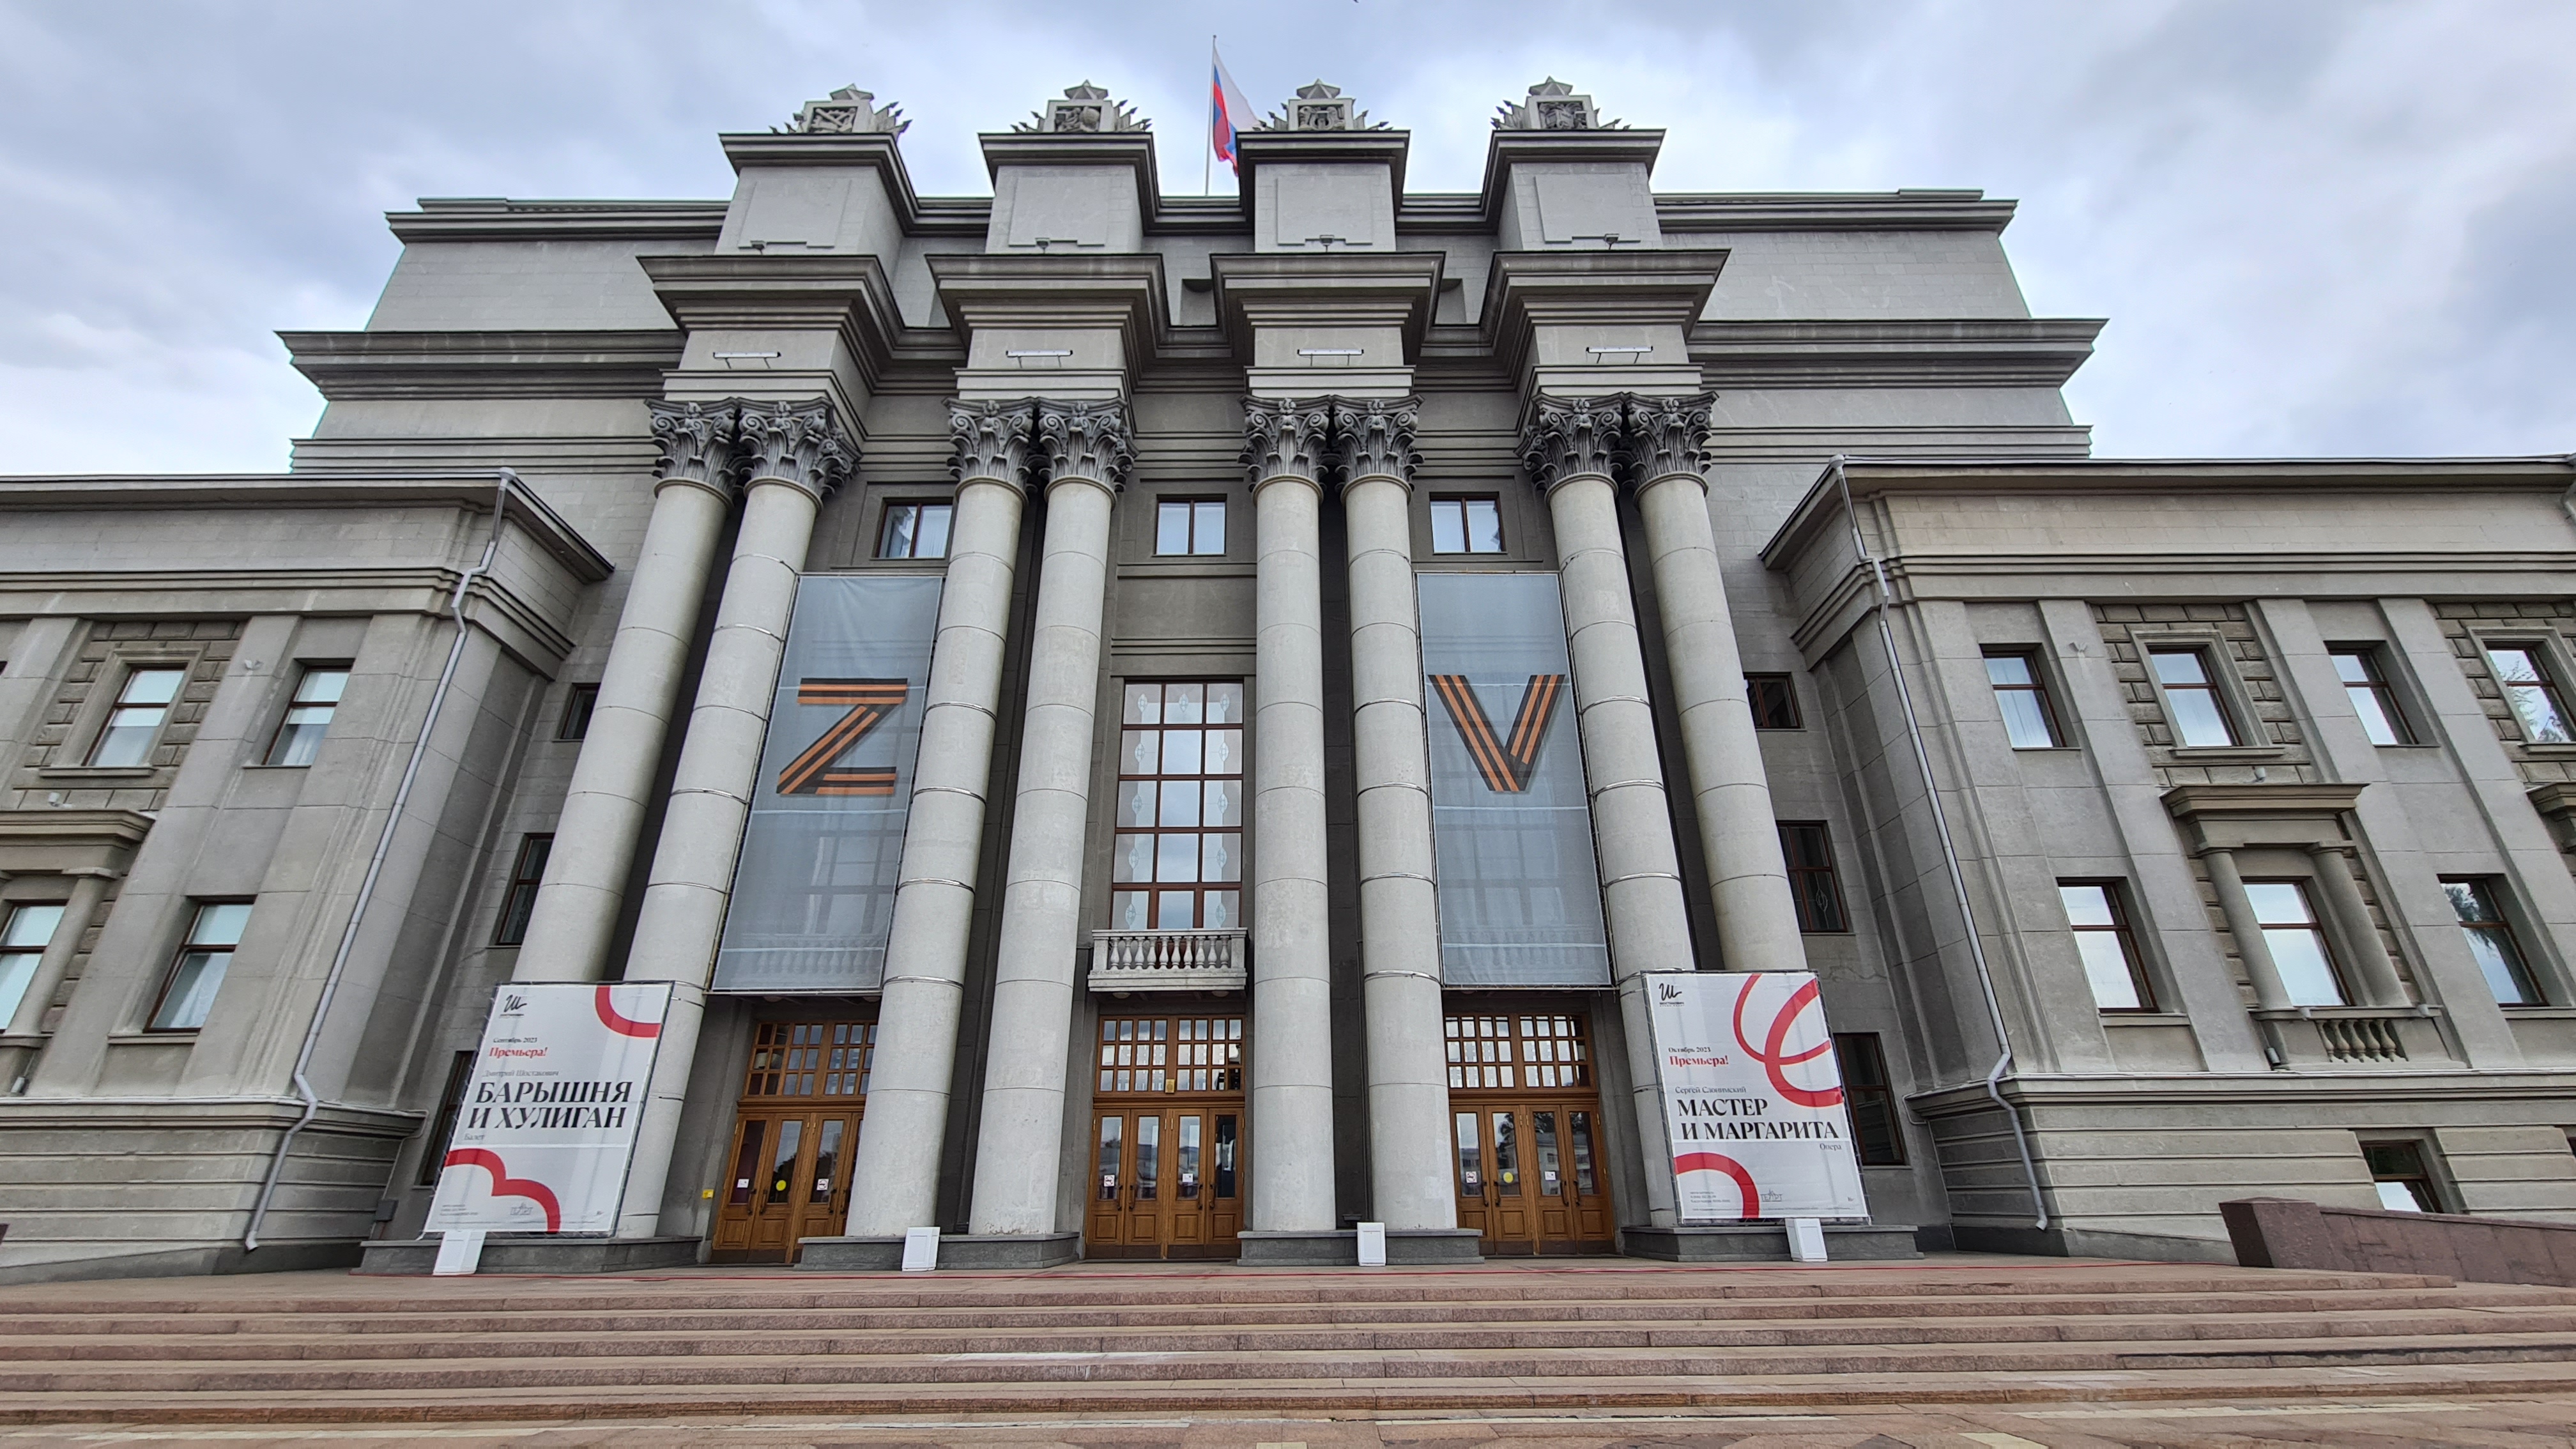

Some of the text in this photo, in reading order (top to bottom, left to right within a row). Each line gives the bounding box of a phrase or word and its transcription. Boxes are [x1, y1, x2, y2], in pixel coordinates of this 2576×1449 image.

[776, 677, 908, 794] Z
[1427, 674, 1565, 792] V
[489, 1046, 548, 1059] Премьера!
[1669, 1055, 1729, 1068] Премьера!
[475, 1082, 633, 1103] БАРЫШНЯ
[1675, 1086, 1701, 1094] Сергей
[1676, 1098, 1768, 1117] МАСТЕР
[468, 1107, 627, 1129] И ХУЛИГАН
[1681, 1121, 1839, 1140] И МАРГАРИТА
[1820, 1142, 1842, 1151] Опера
